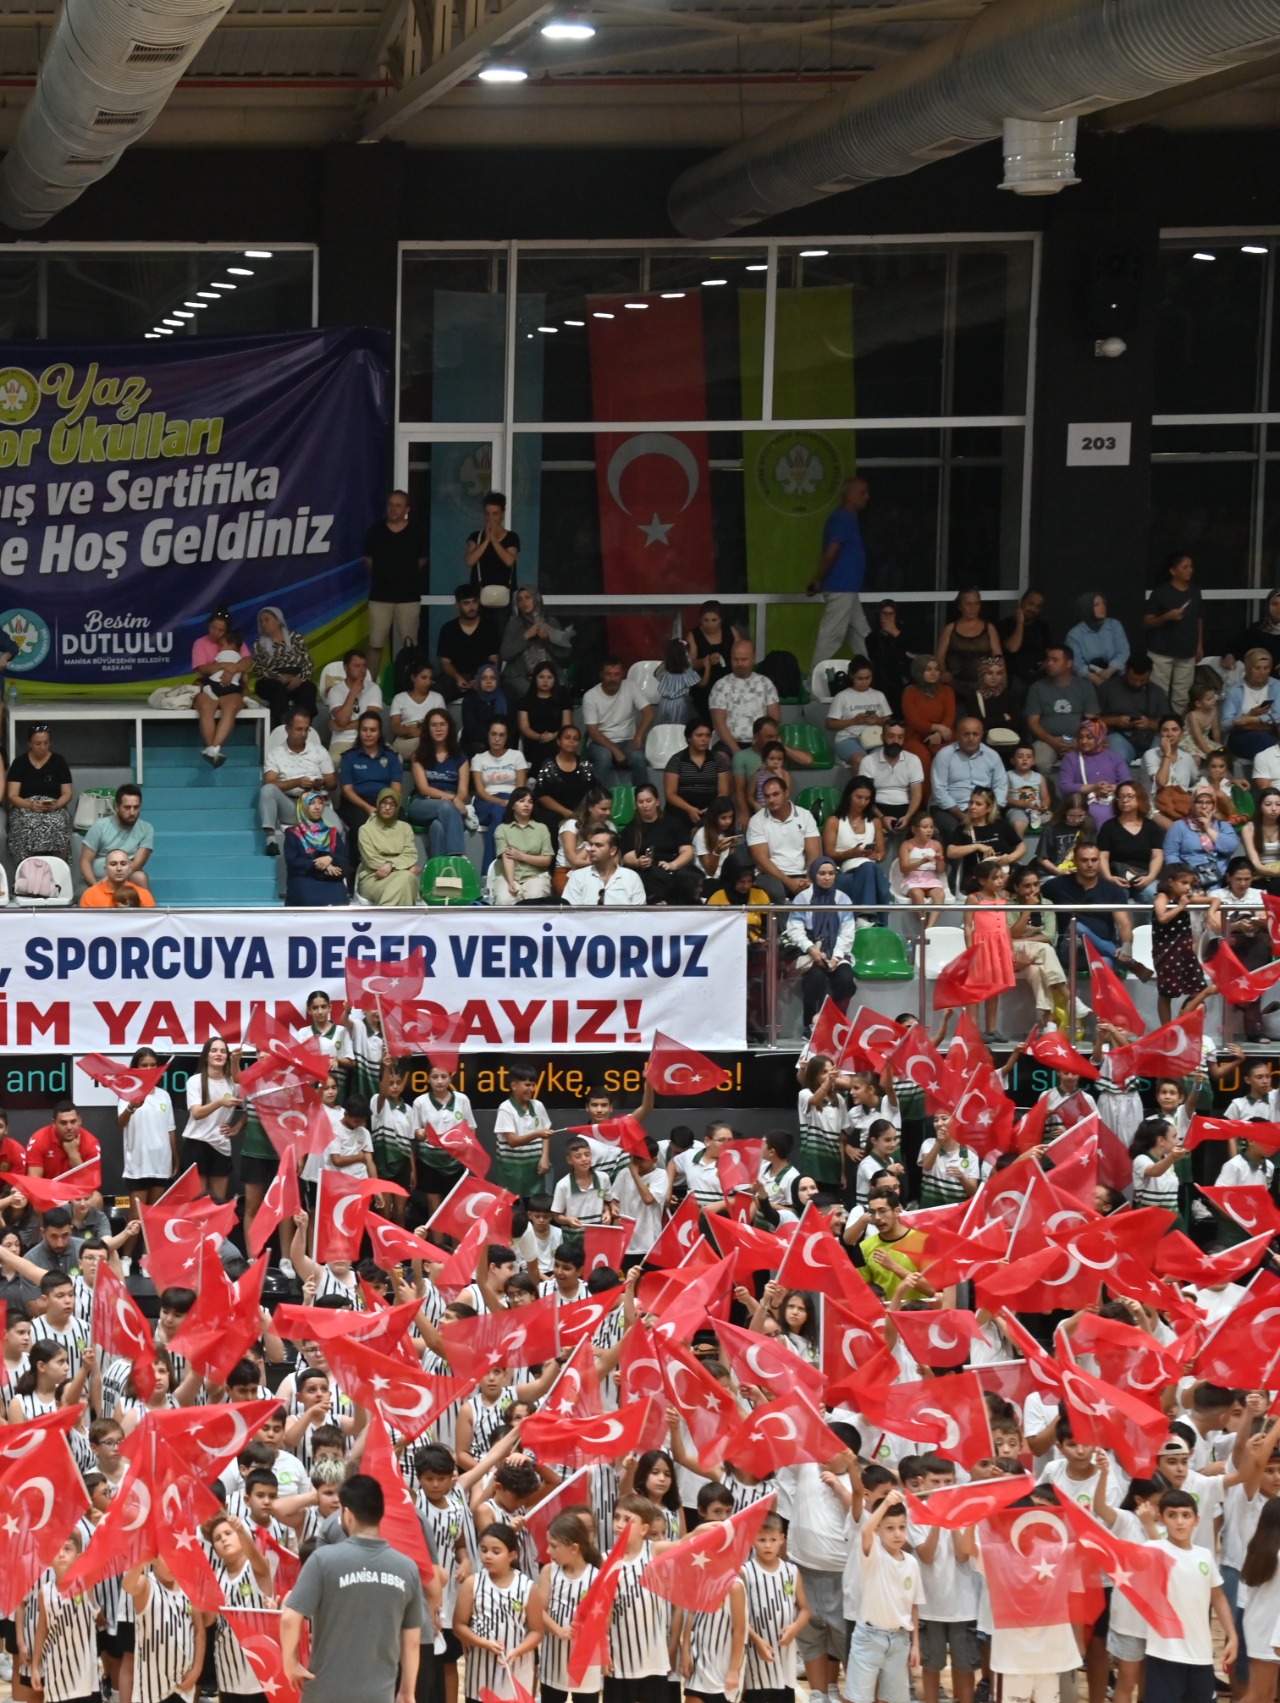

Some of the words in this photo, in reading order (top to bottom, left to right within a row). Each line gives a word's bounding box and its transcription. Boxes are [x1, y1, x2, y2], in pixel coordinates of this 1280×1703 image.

[40, 362, 152, 425] Yaz
[48, 411, 224, 465] Okulları
[1081, 436, 1117, 450] 203
[47, 484, 94, 516] ve
[103, 461, 280, 512] Sertifika
[38, 524, 128, 578] Hoş
[140, 506, 336, 567] Geldiniz
[84, 610, 151, 633] Besim
[62, 632, 173, 655] DUTLULU
[25, 936, 274, 980] SPORCUYA
[288, 922, 437, 978] DEĞER
[449, 922, 709, 979] VERİYORUZ
[6, 1062, 66, 1092] and
[339, 1566, 379, 1588] MANİSA
[380, 1571, 406, 1592] BBSK
